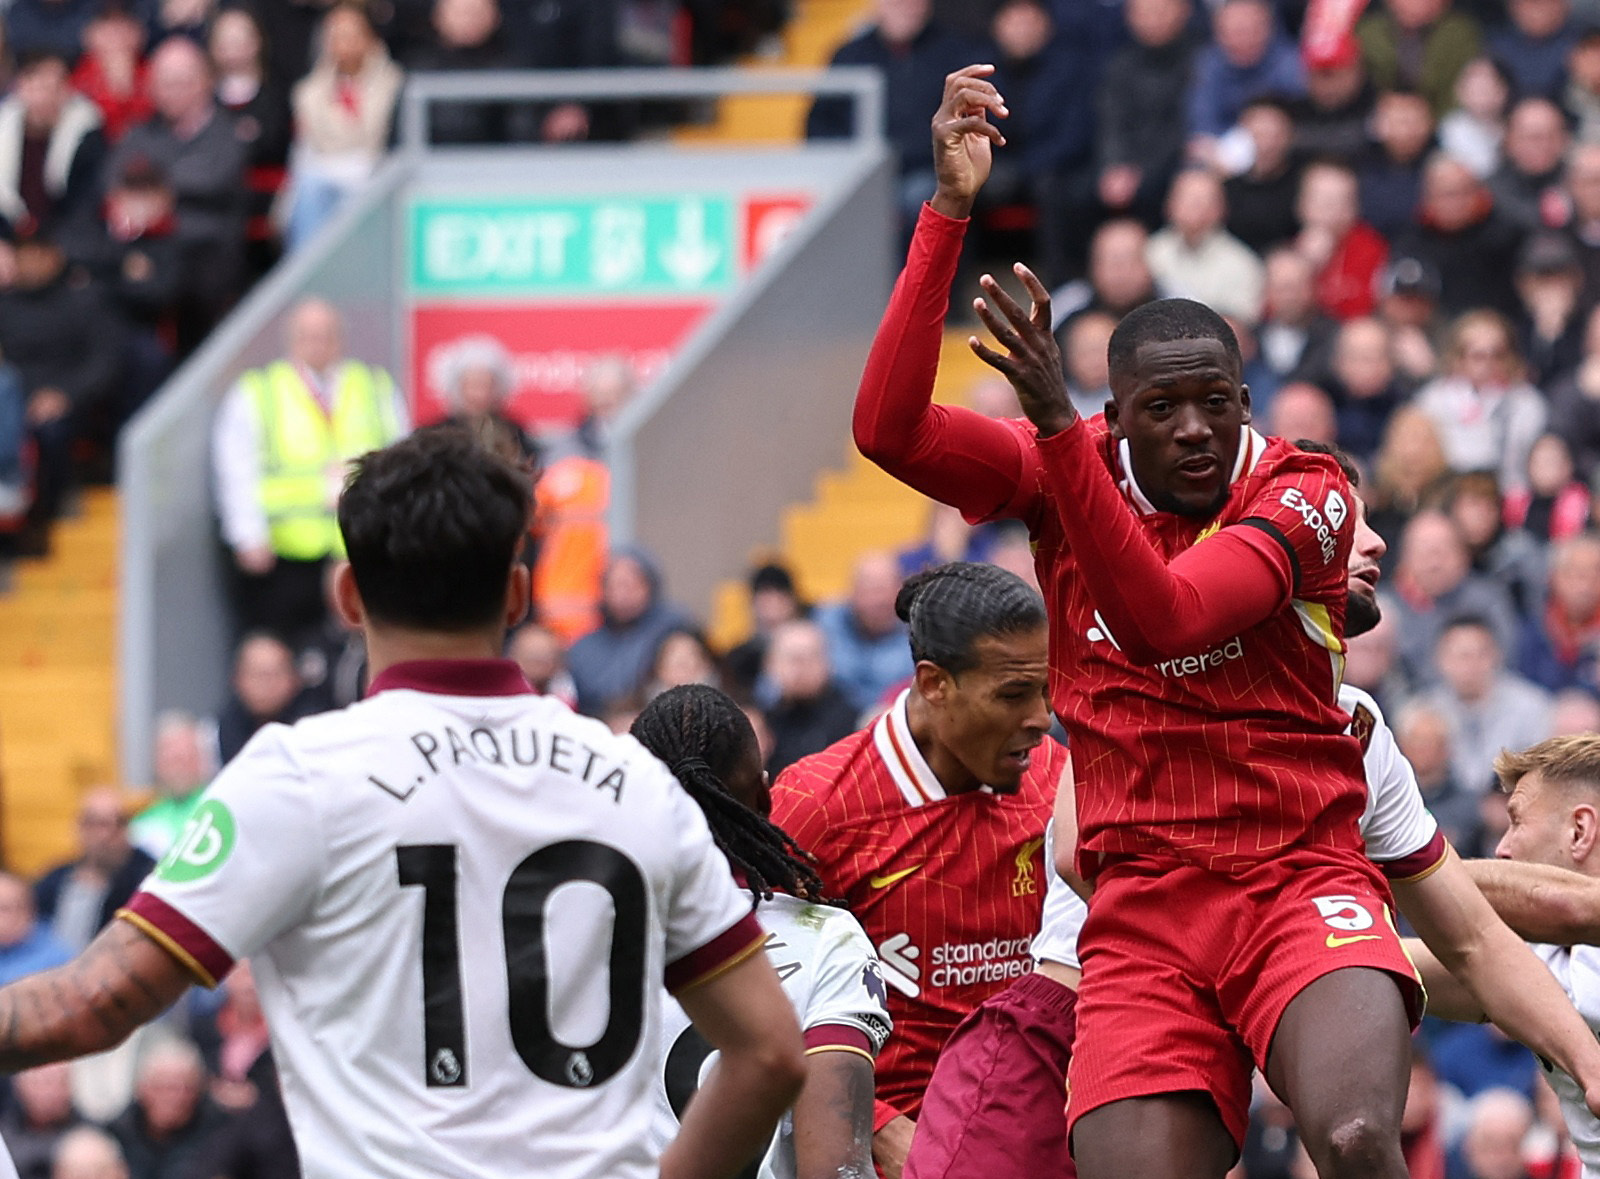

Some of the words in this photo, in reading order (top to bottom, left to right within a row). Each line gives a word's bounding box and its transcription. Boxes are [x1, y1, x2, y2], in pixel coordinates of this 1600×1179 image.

[424, 211, 581, 281] EXIT
[1280, 487, 1337, 565] Expedia
[1154, 636, 1243, 678] rtered
[1012, 880, 1037, 897] LFC
[1311, 895, 1374, 931] 5
[396, 839, 649, 1089] 10
[931, 933, 1033, 965] standard
